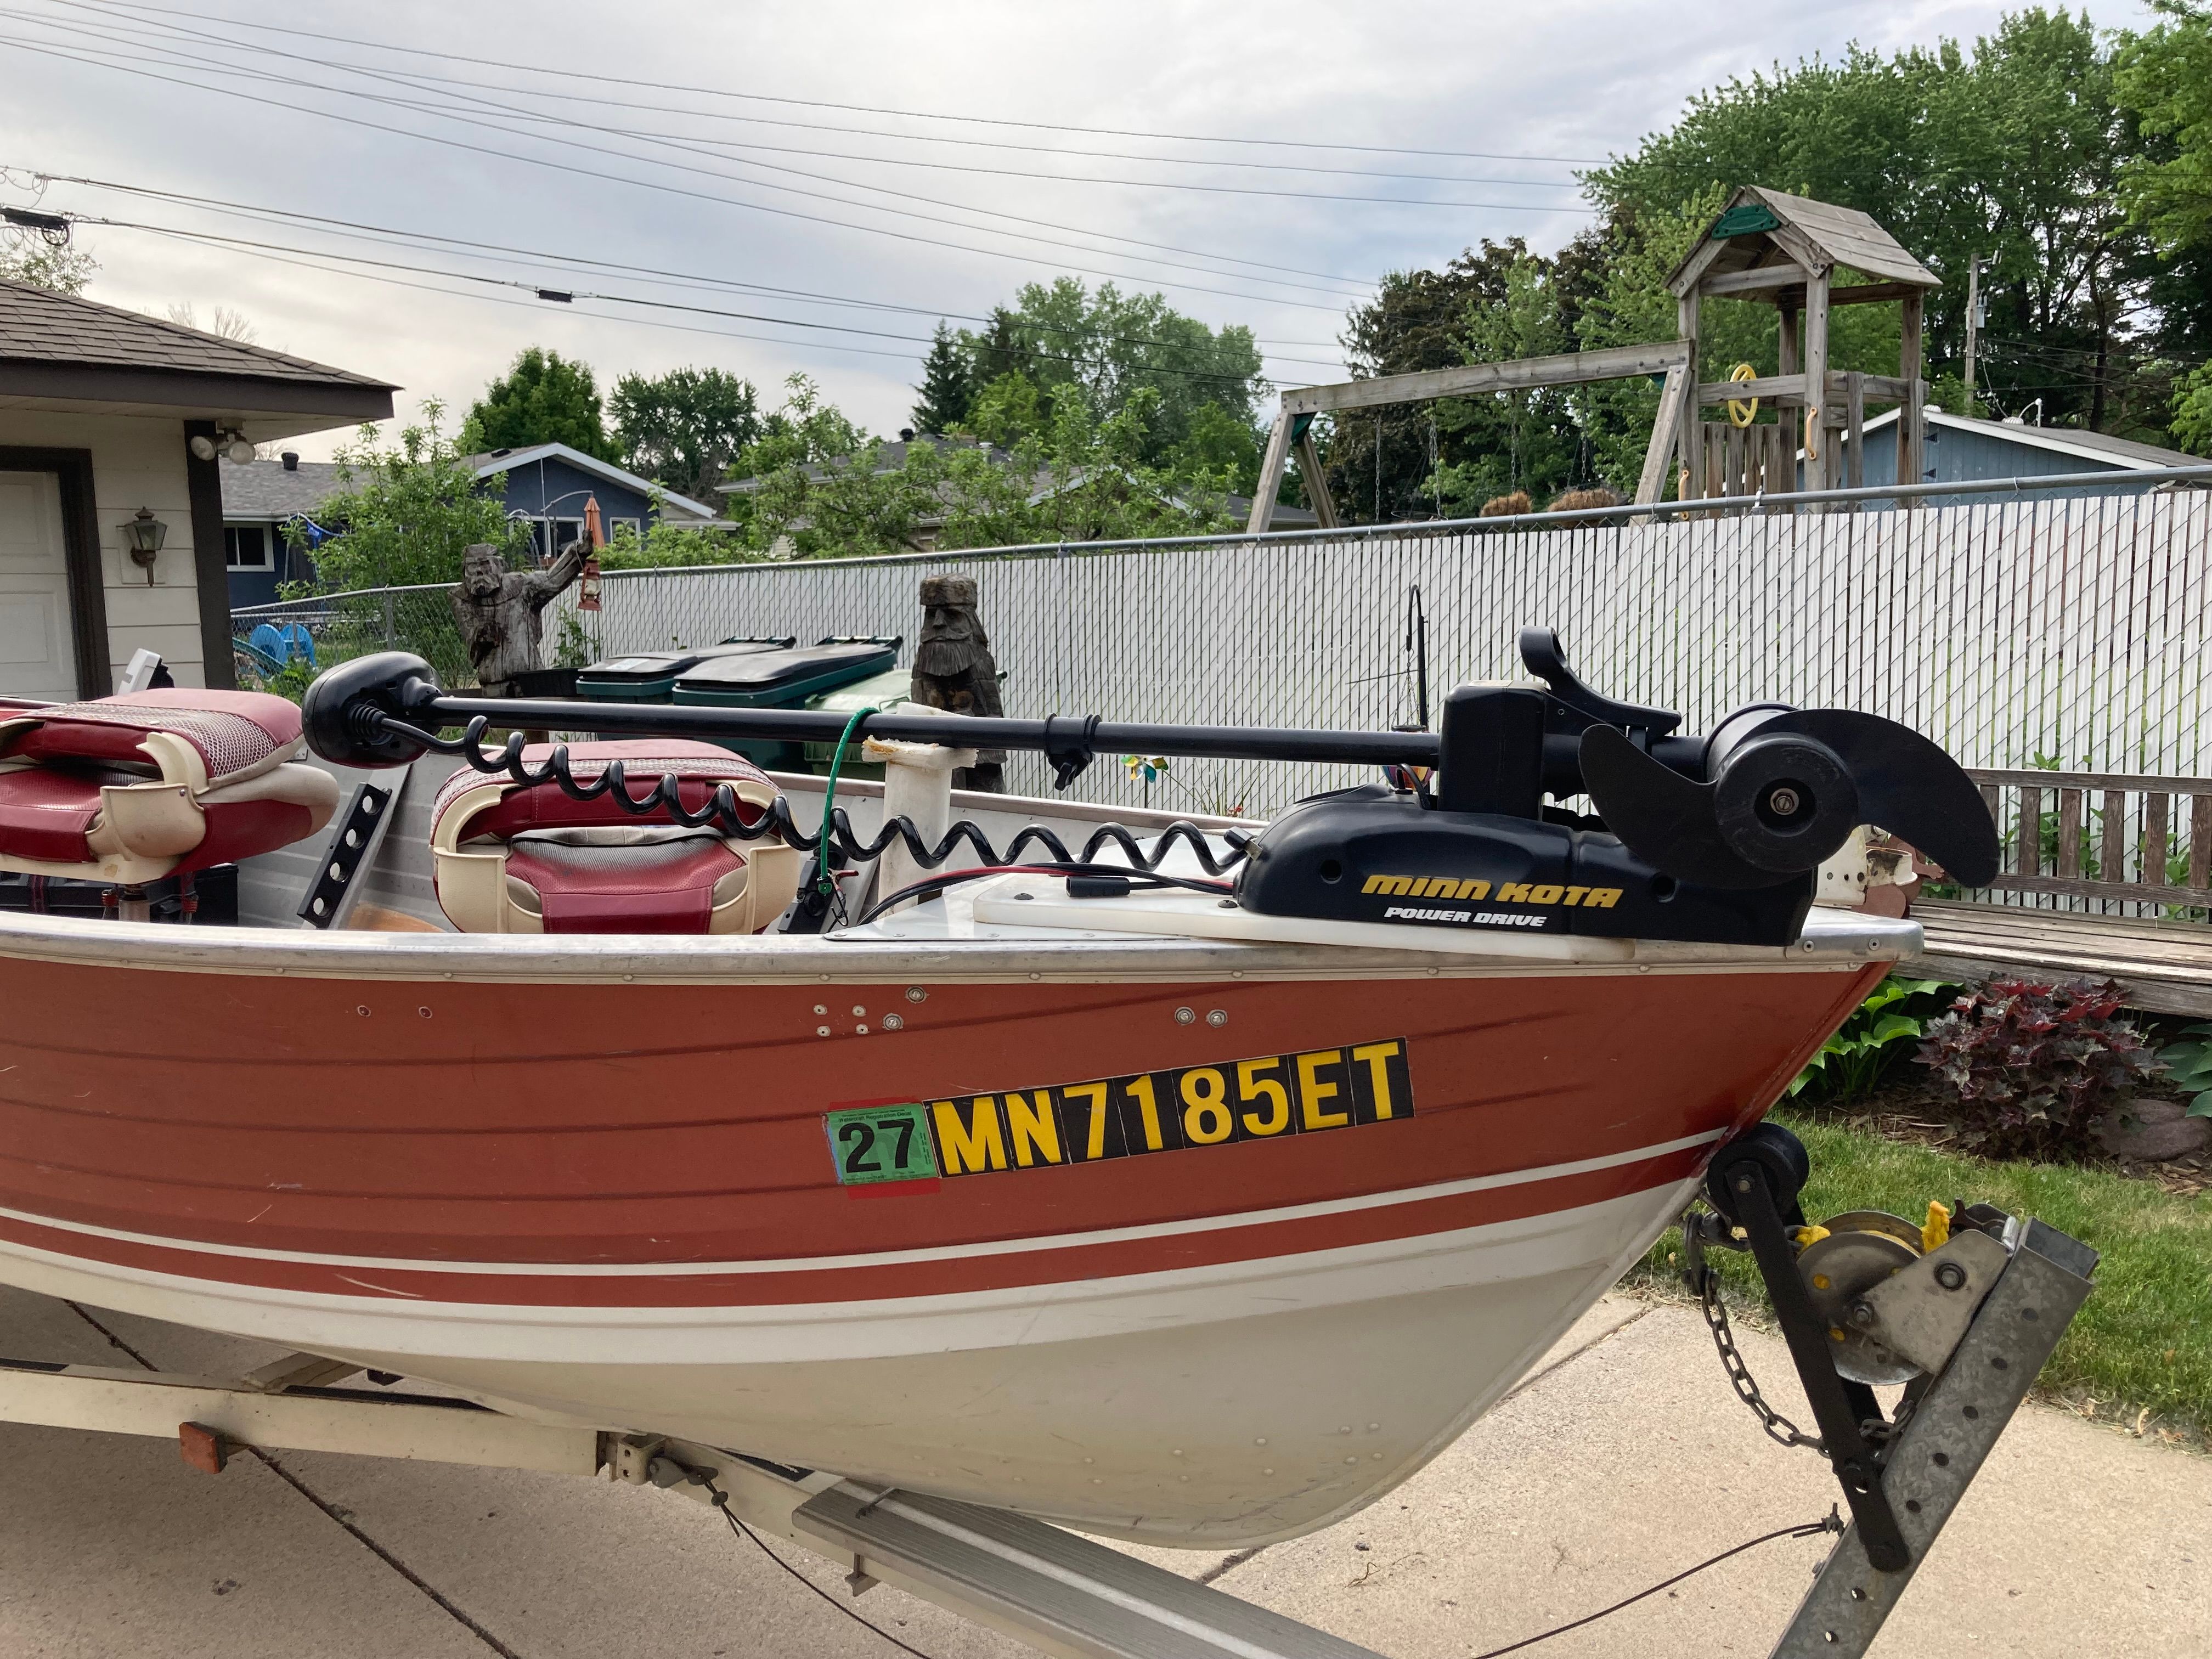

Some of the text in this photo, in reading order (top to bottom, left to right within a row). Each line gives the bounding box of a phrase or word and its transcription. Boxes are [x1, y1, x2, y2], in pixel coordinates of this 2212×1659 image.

[1495, 882, 1624, 908] KOTA
[1384, 907, 1547, 927] POWER DRIVE
[838, 1118, 916, 1173] 27
